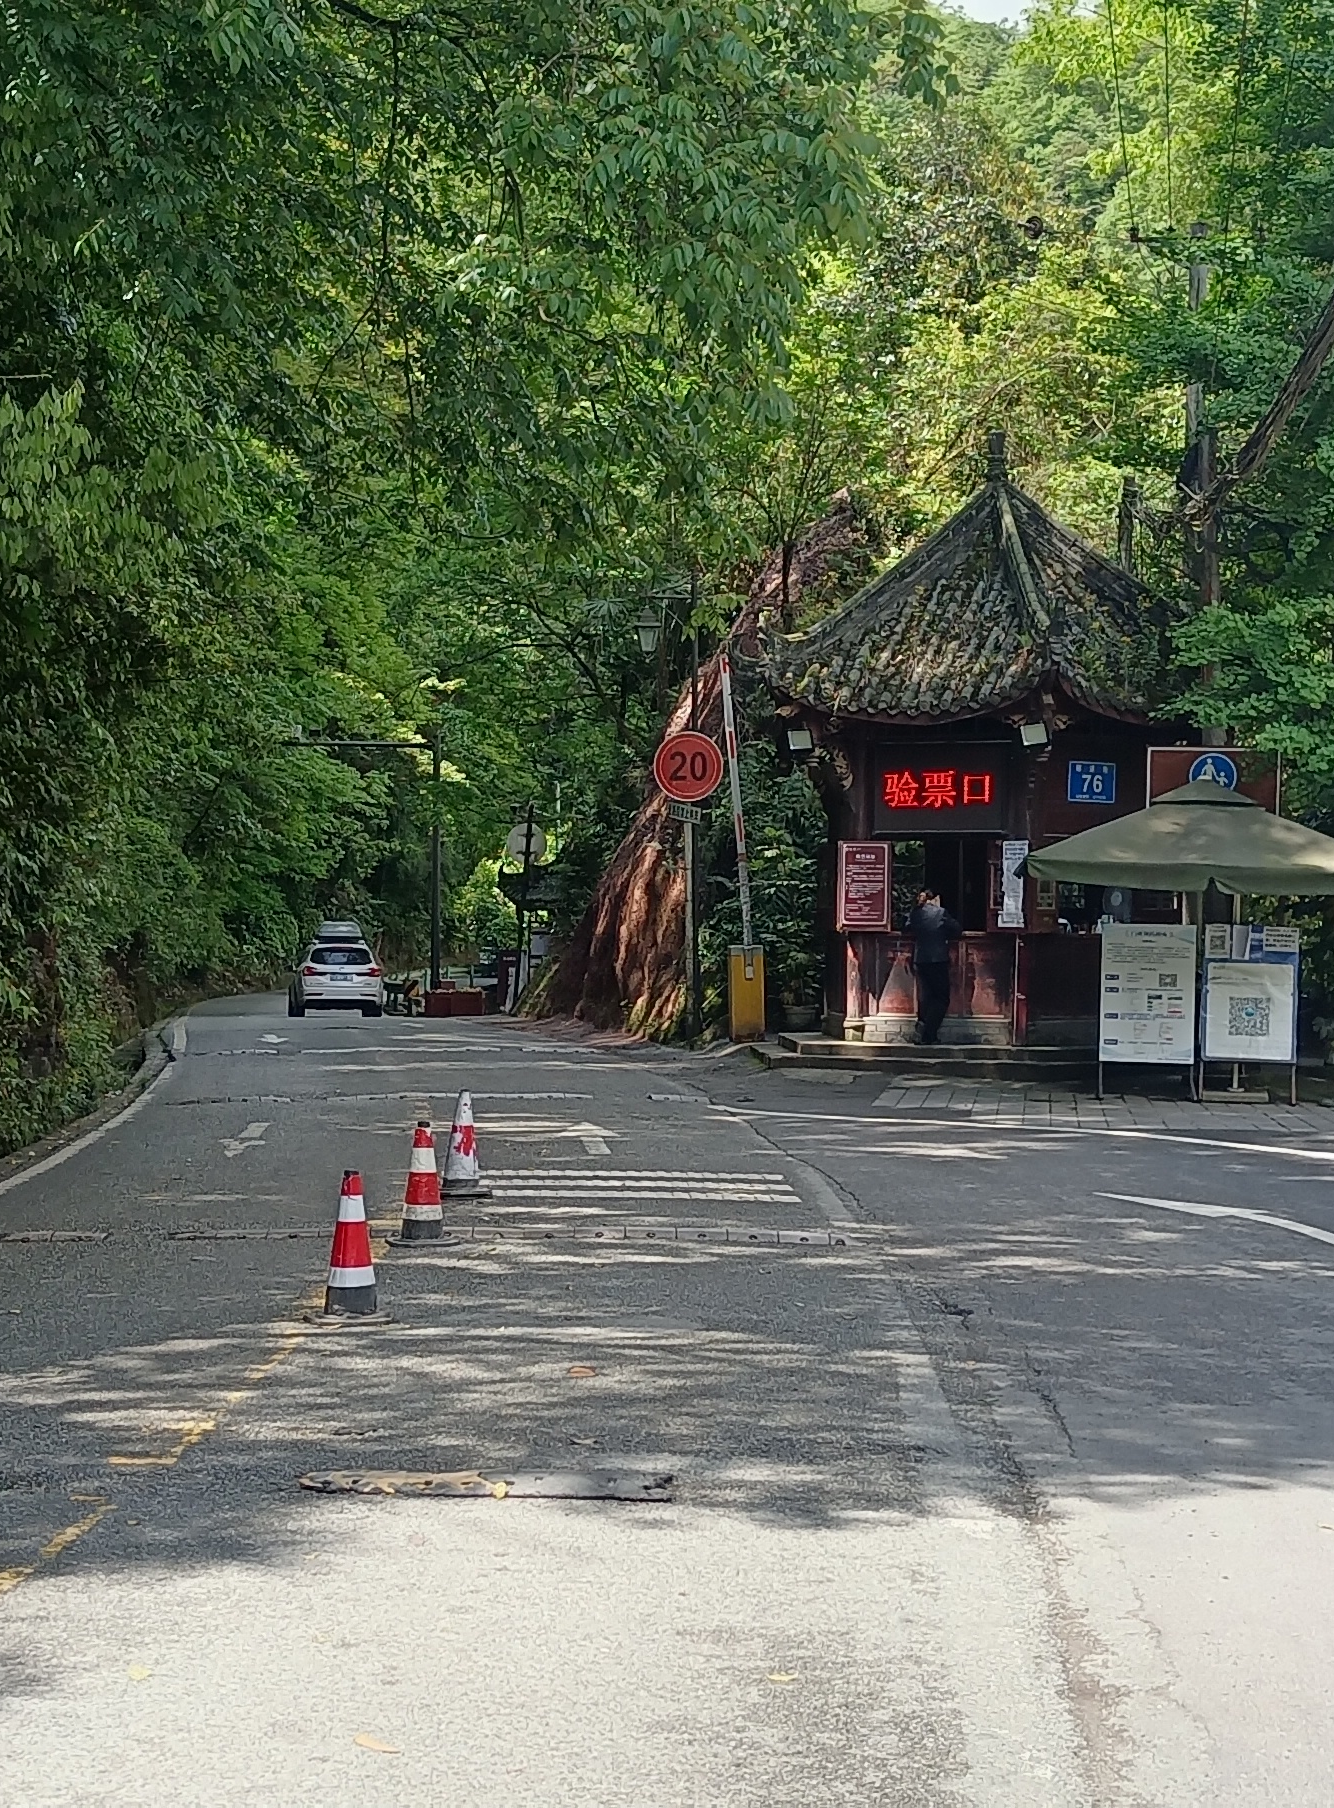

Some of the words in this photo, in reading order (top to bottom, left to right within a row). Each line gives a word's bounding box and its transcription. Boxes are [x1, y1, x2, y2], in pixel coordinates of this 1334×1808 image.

[669, 751, 708, 781] 20
[884, 770, 991, 808] 验票口
[1082, 774, 1103, 793] 76
